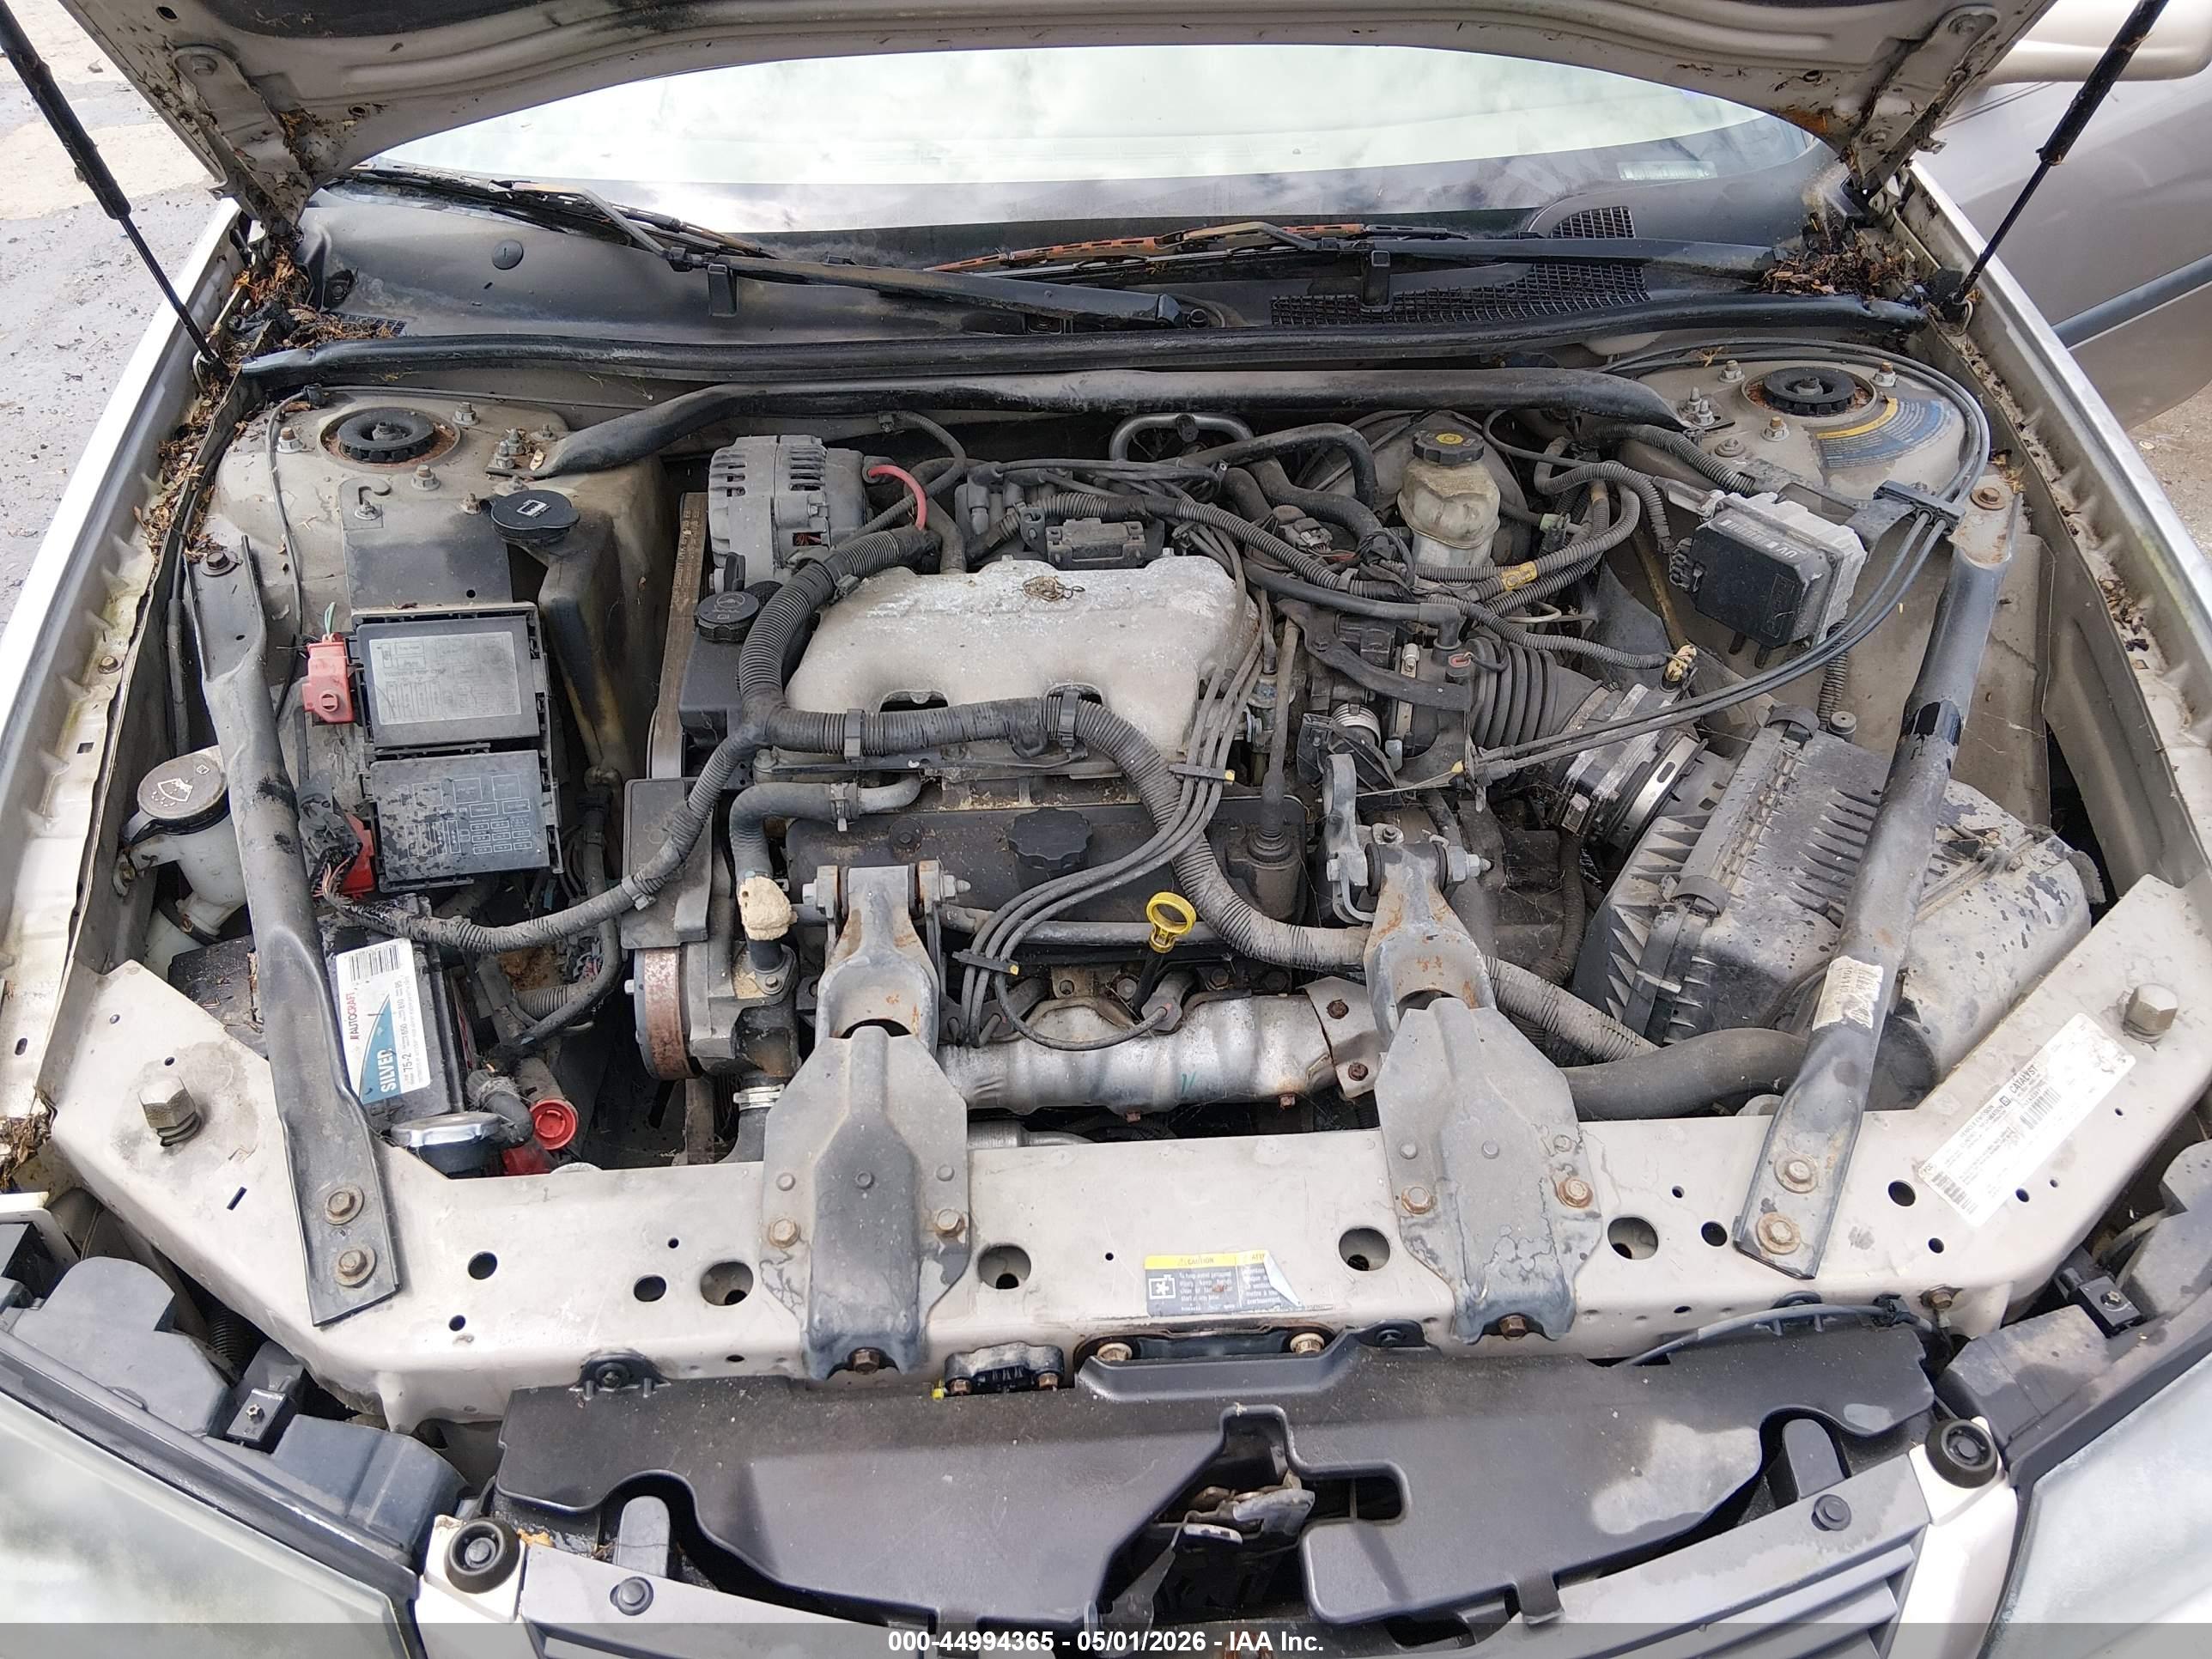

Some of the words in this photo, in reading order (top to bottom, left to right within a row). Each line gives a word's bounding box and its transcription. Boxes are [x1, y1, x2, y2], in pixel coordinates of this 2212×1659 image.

[345, 992, 360, 1035] AUTOCRAFT
[377, 1048, 398, 1093] SILVER
[401, 1052, 413, 1073] 75-2
[2008, 1064, 2039, 1094] CATALYST
